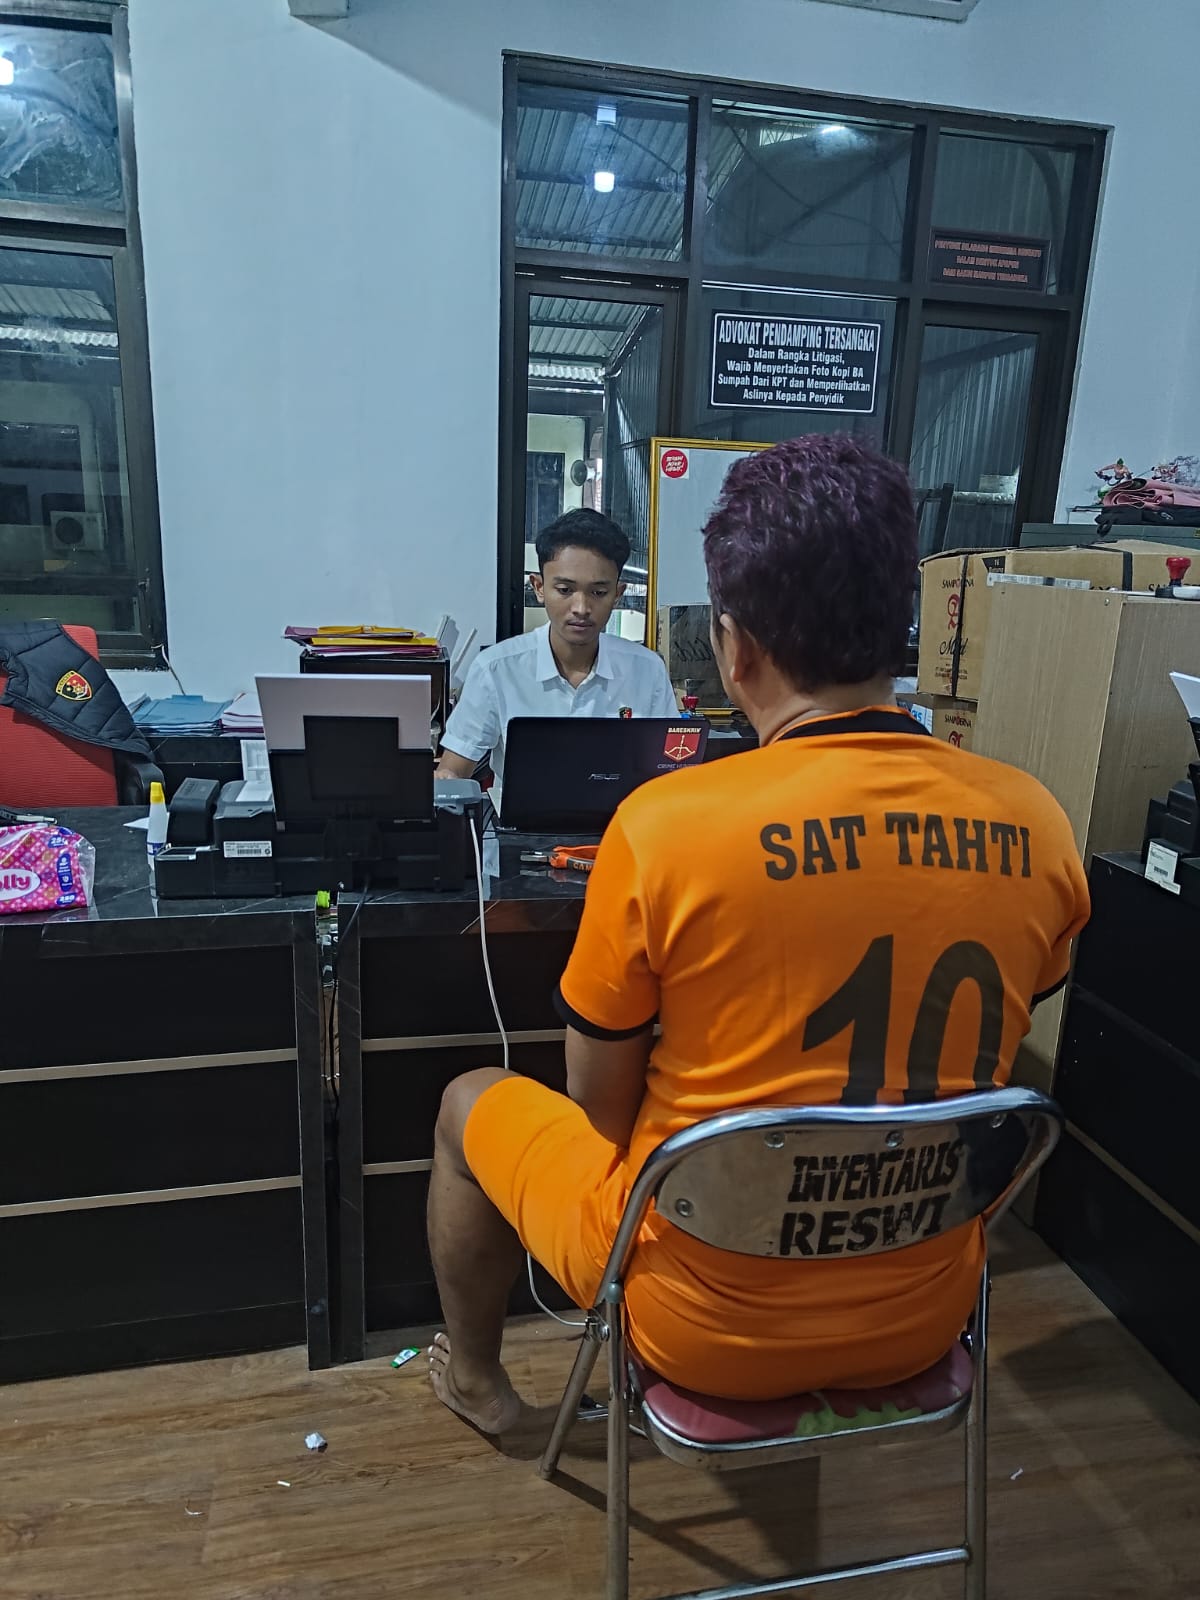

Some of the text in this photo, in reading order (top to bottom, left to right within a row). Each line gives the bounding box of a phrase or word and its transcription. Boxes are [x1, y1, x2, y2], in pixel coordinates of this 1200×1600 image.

[719, 319, 875, 351] ADVOKAT PENDAMPING TERSANGKA
[748, 347, 845, 365] Dalam Rangka Litigasi,
[727, 360, 864, 379] Wajib Menyertakan Foto Kopi BA
[718, 373, 871, 392] Sumpah Dari KPT dan Memperlihatkan
[743, 388, 845, 405] Aslinya Kepada Penyidik
[760, 812, 1032, 881] SAT TAHTI
[802, 934, 1005, 1105] 10
[788, 1141, 963, 1202] INVENTARIS
